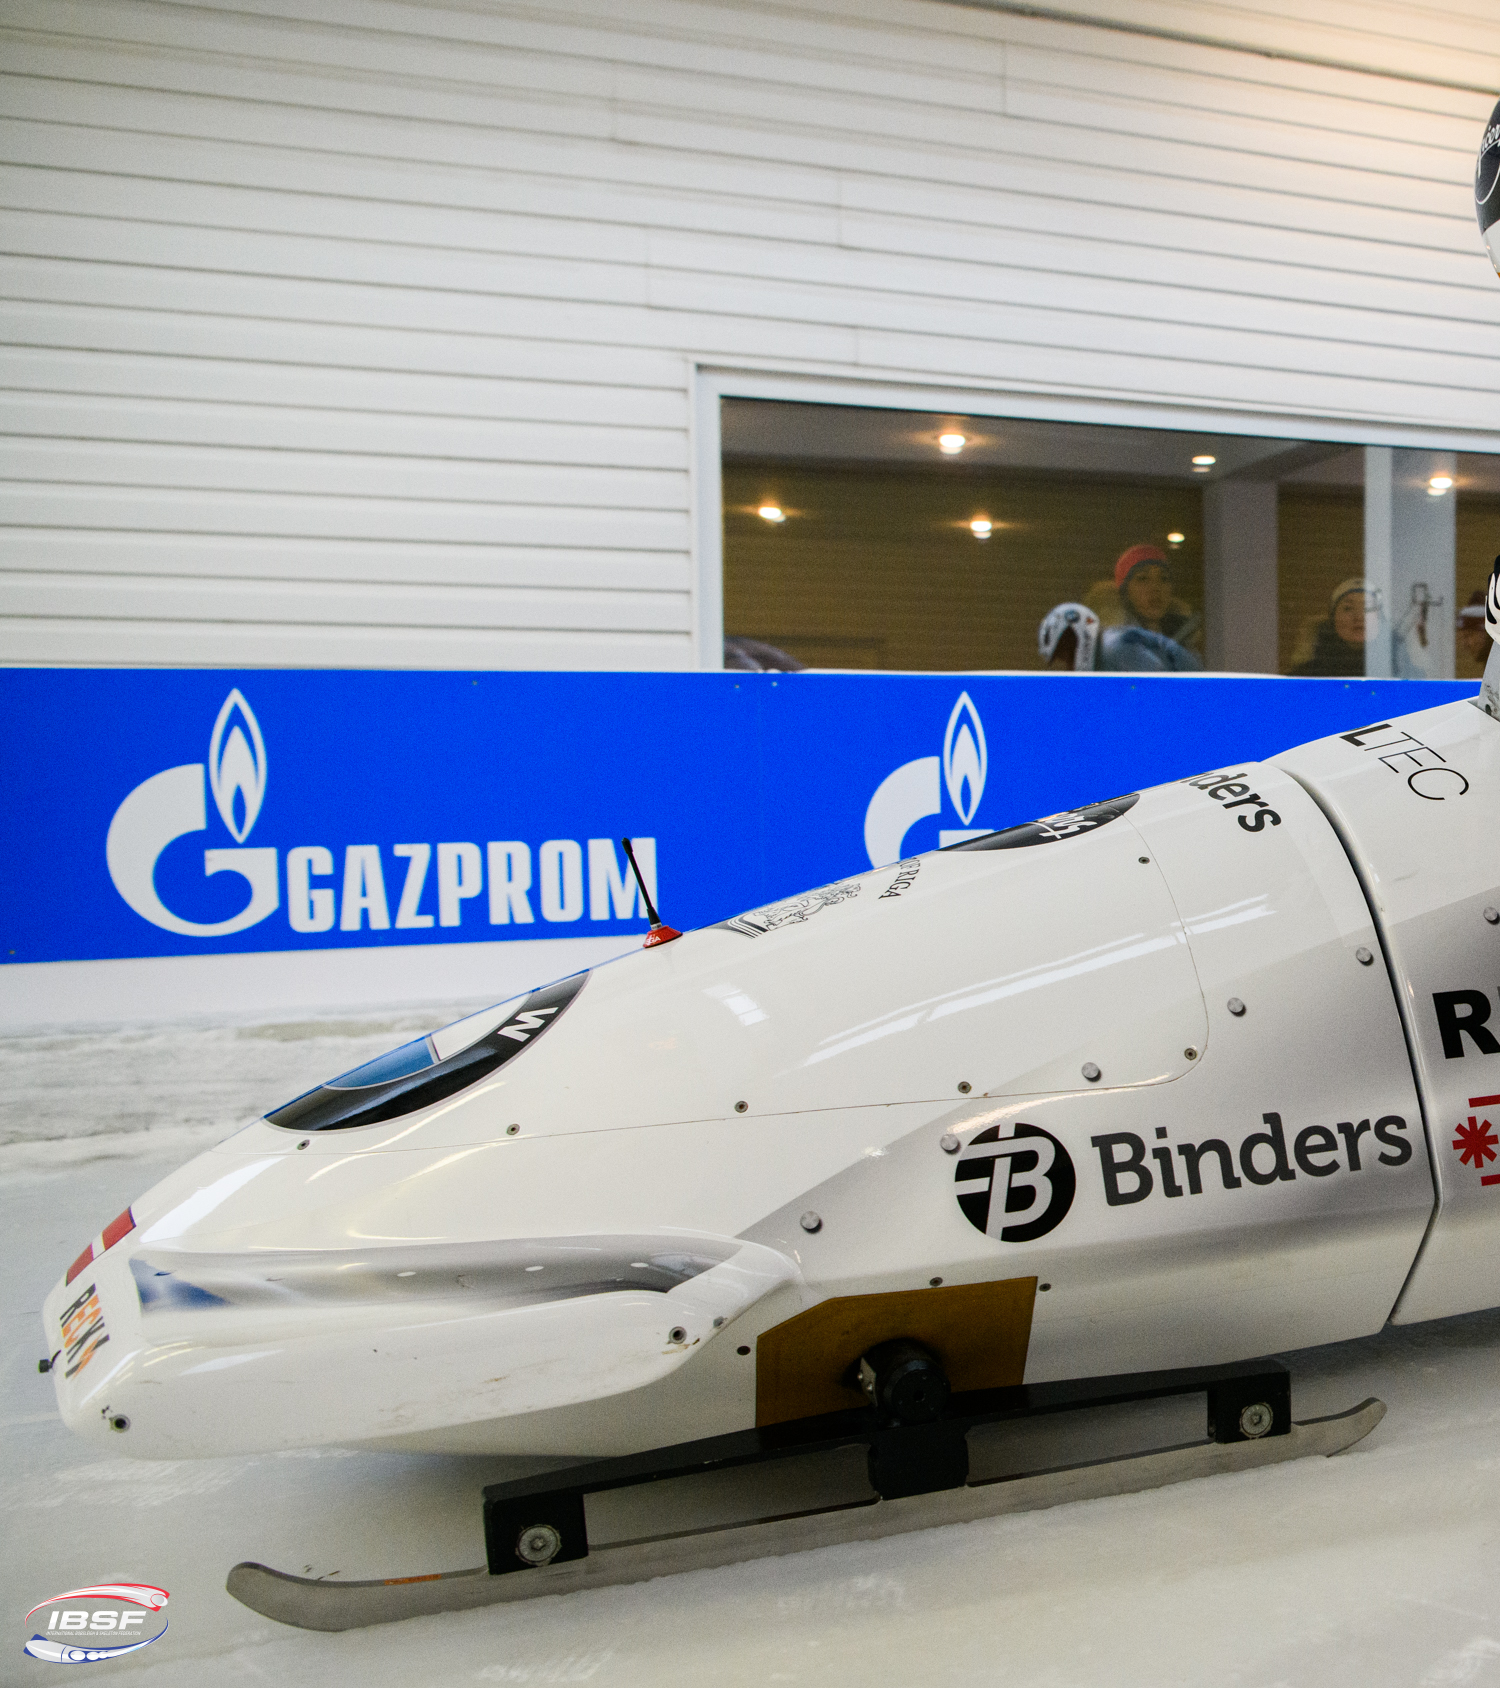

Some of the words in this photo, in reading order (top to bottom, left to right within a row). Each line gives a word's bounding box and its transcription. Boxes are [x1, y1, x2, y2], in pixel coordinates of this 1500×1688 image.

[1339, 723, 1470, 801] LTEC
[286, 837, 657, 933] GAZPROM
[879, 869, 920, 899] RIGA
[1091, 1112, 1413, 1207] Binders
